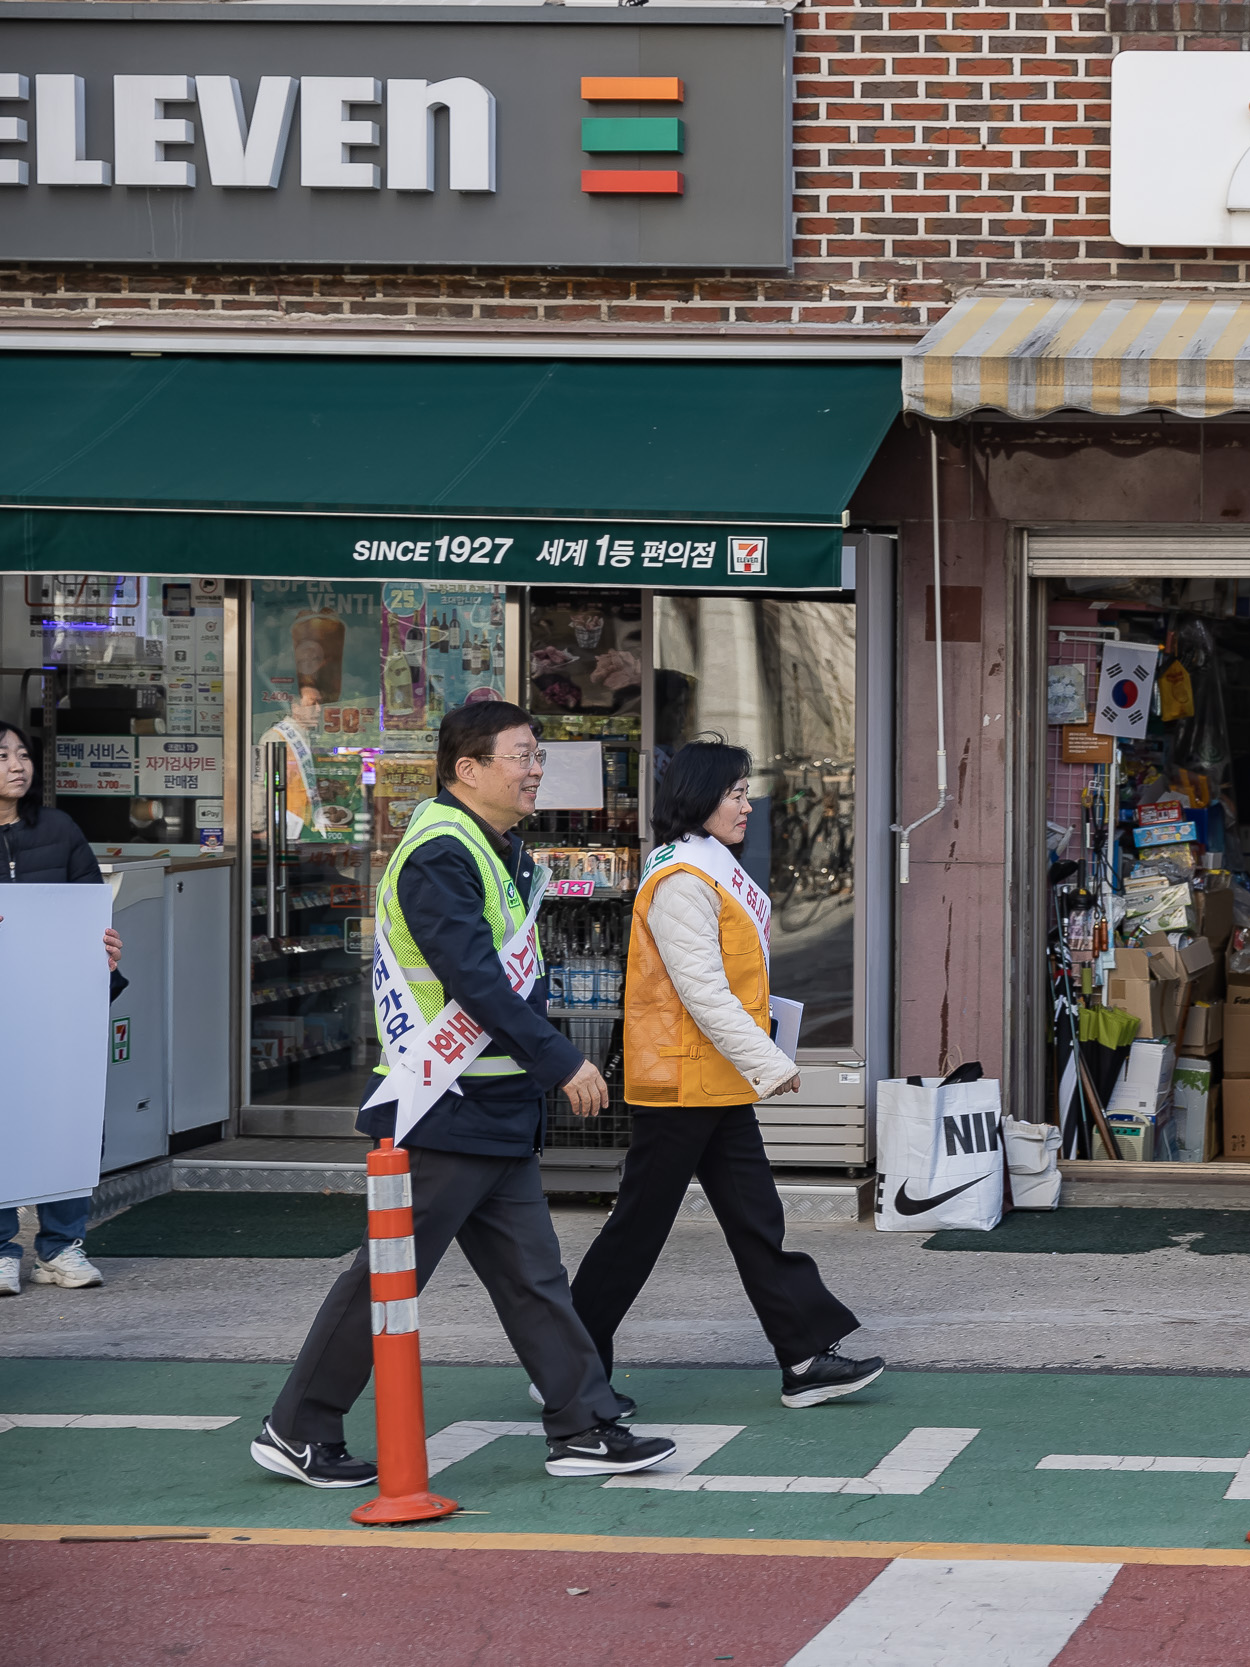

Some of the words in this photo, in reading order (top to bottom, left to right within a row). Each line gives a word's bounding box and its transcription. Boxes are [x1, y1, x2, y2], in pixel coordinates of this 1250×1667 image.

[352, 539, 430, 562] SINCE
[433, 535, 515, 564] 1927
[535, 538, 588, 566] 세계
[594, 534, 634, 568] 1등
[640, 539, 717, 569] 편의점
[308, 594, 374, 615] VENTI
[390, 589, 415, 609] 25
[56, 743, 84, 760] 택배
[87, 743, 129, 760] 서비스
[145, 757, 217, 771] 자가검사키트
[164, 775, 199, 789] 판매점
[560, 881, 591, 895] 1+1
